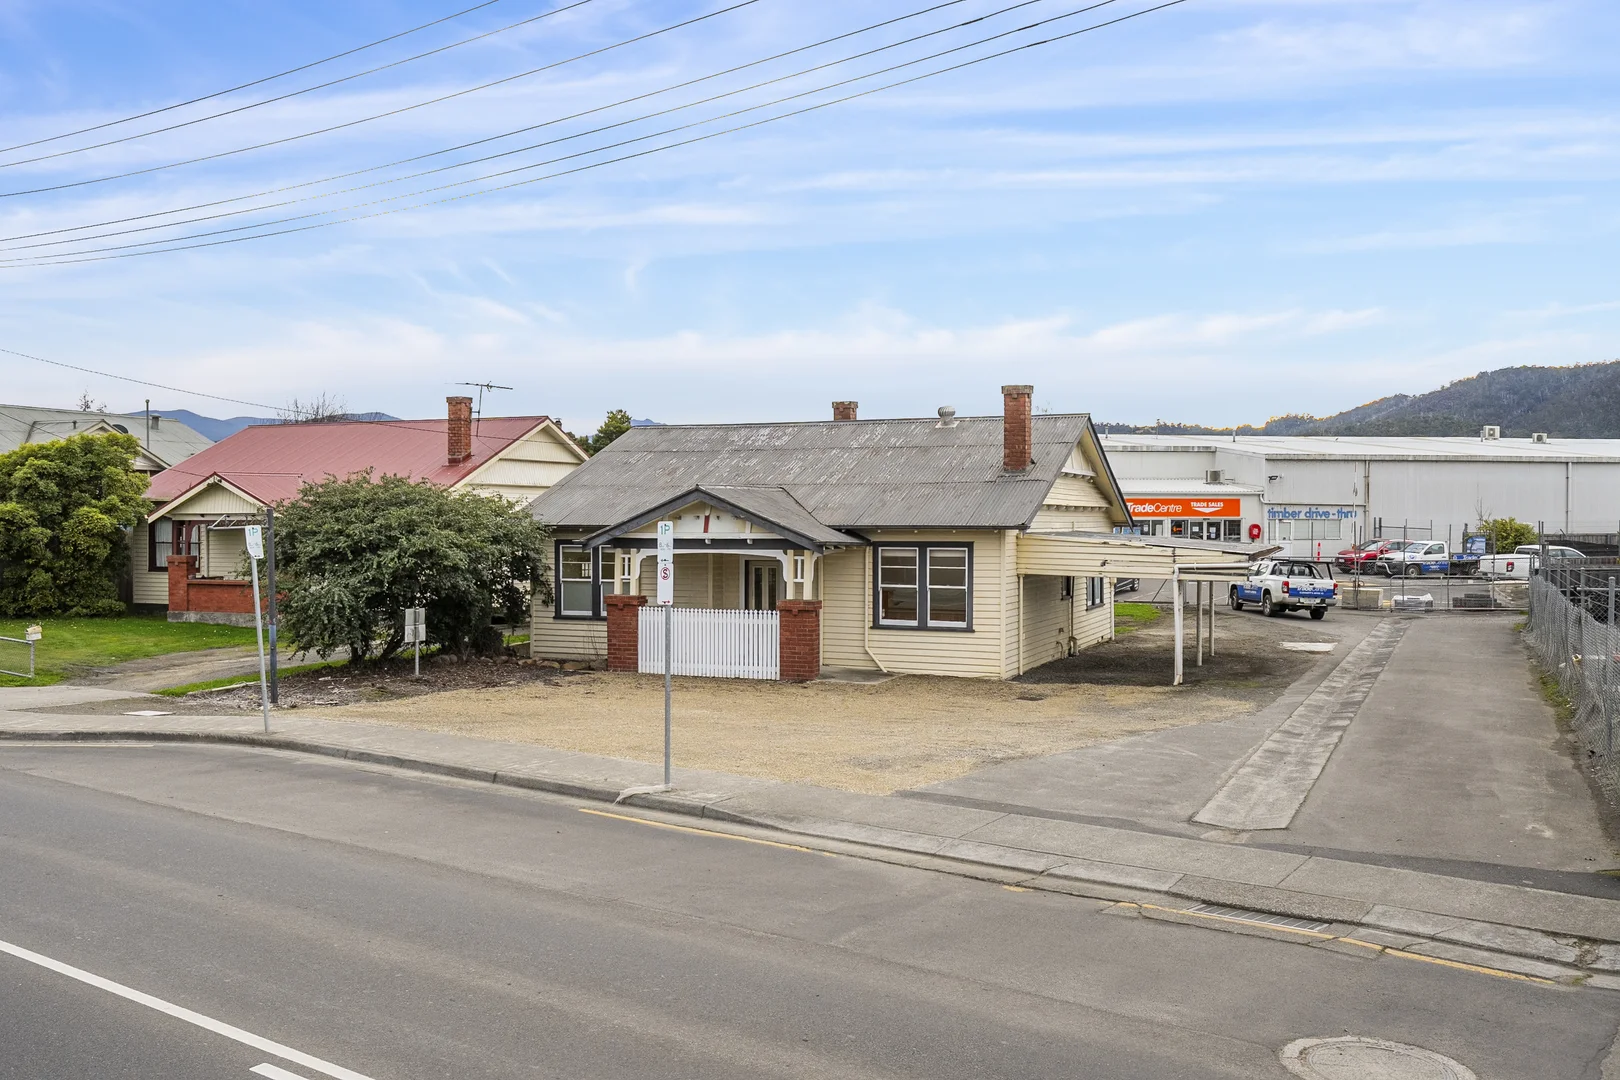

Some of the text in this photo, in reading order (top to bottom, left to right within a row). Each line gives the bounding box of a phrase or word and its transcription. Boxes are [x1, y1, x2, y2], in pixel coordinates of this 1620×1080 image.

[1126, 502, 1182, 513] TradeCentre
[1267, 507, 1302, 519] timber
[248, 527, 259, 537] 1P
[660, 524, 671, 535] 1P
